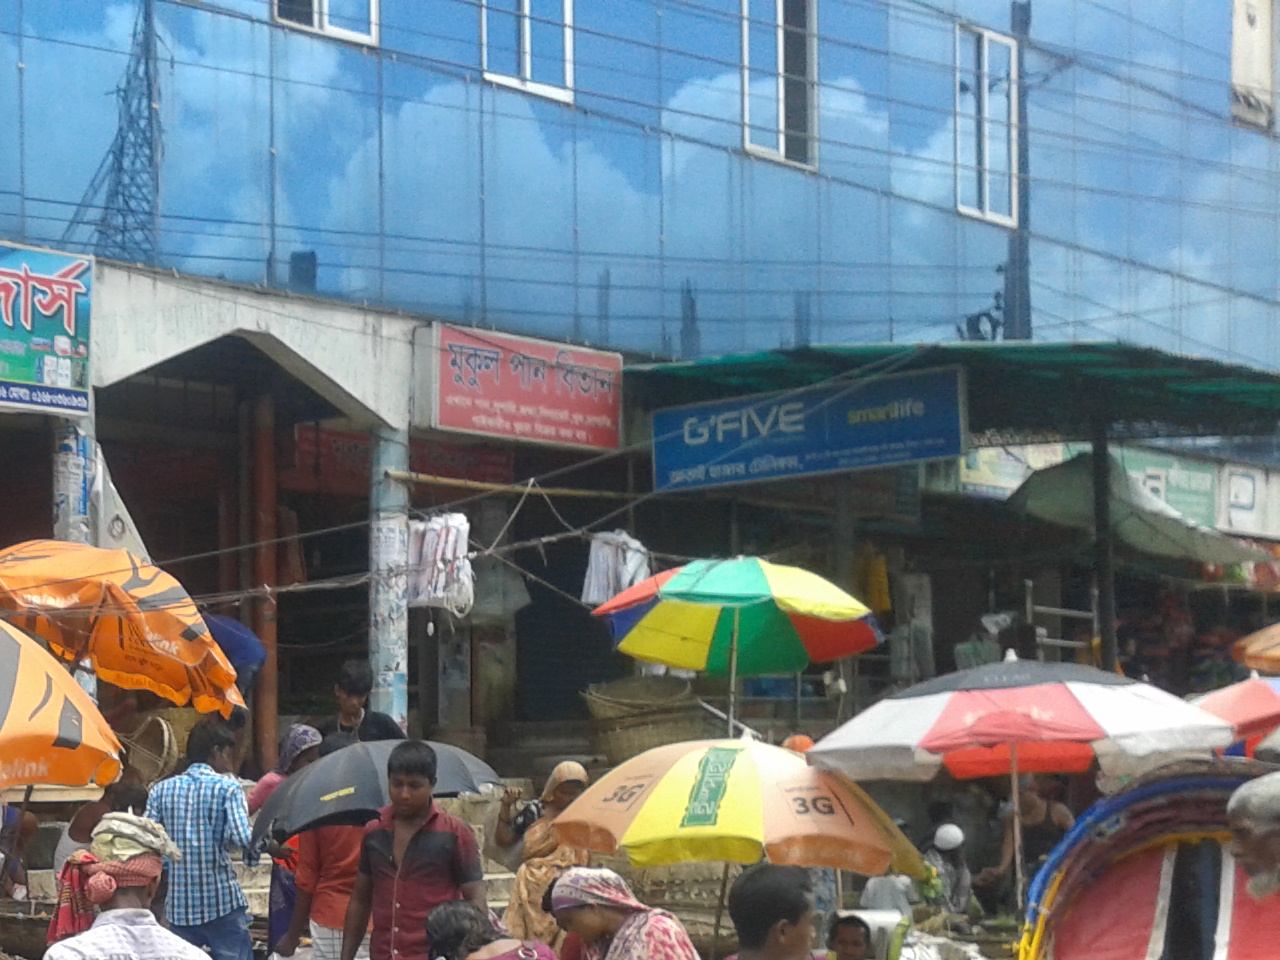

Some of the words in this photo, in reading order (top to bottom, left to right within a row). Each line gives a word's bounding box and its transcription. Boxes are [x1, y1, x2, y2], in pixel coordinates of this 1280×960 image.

[447, 343, 503, 392] মুকুল
[509, 354, 547, 393] পান
[792, 796, 835, 816] 3G
